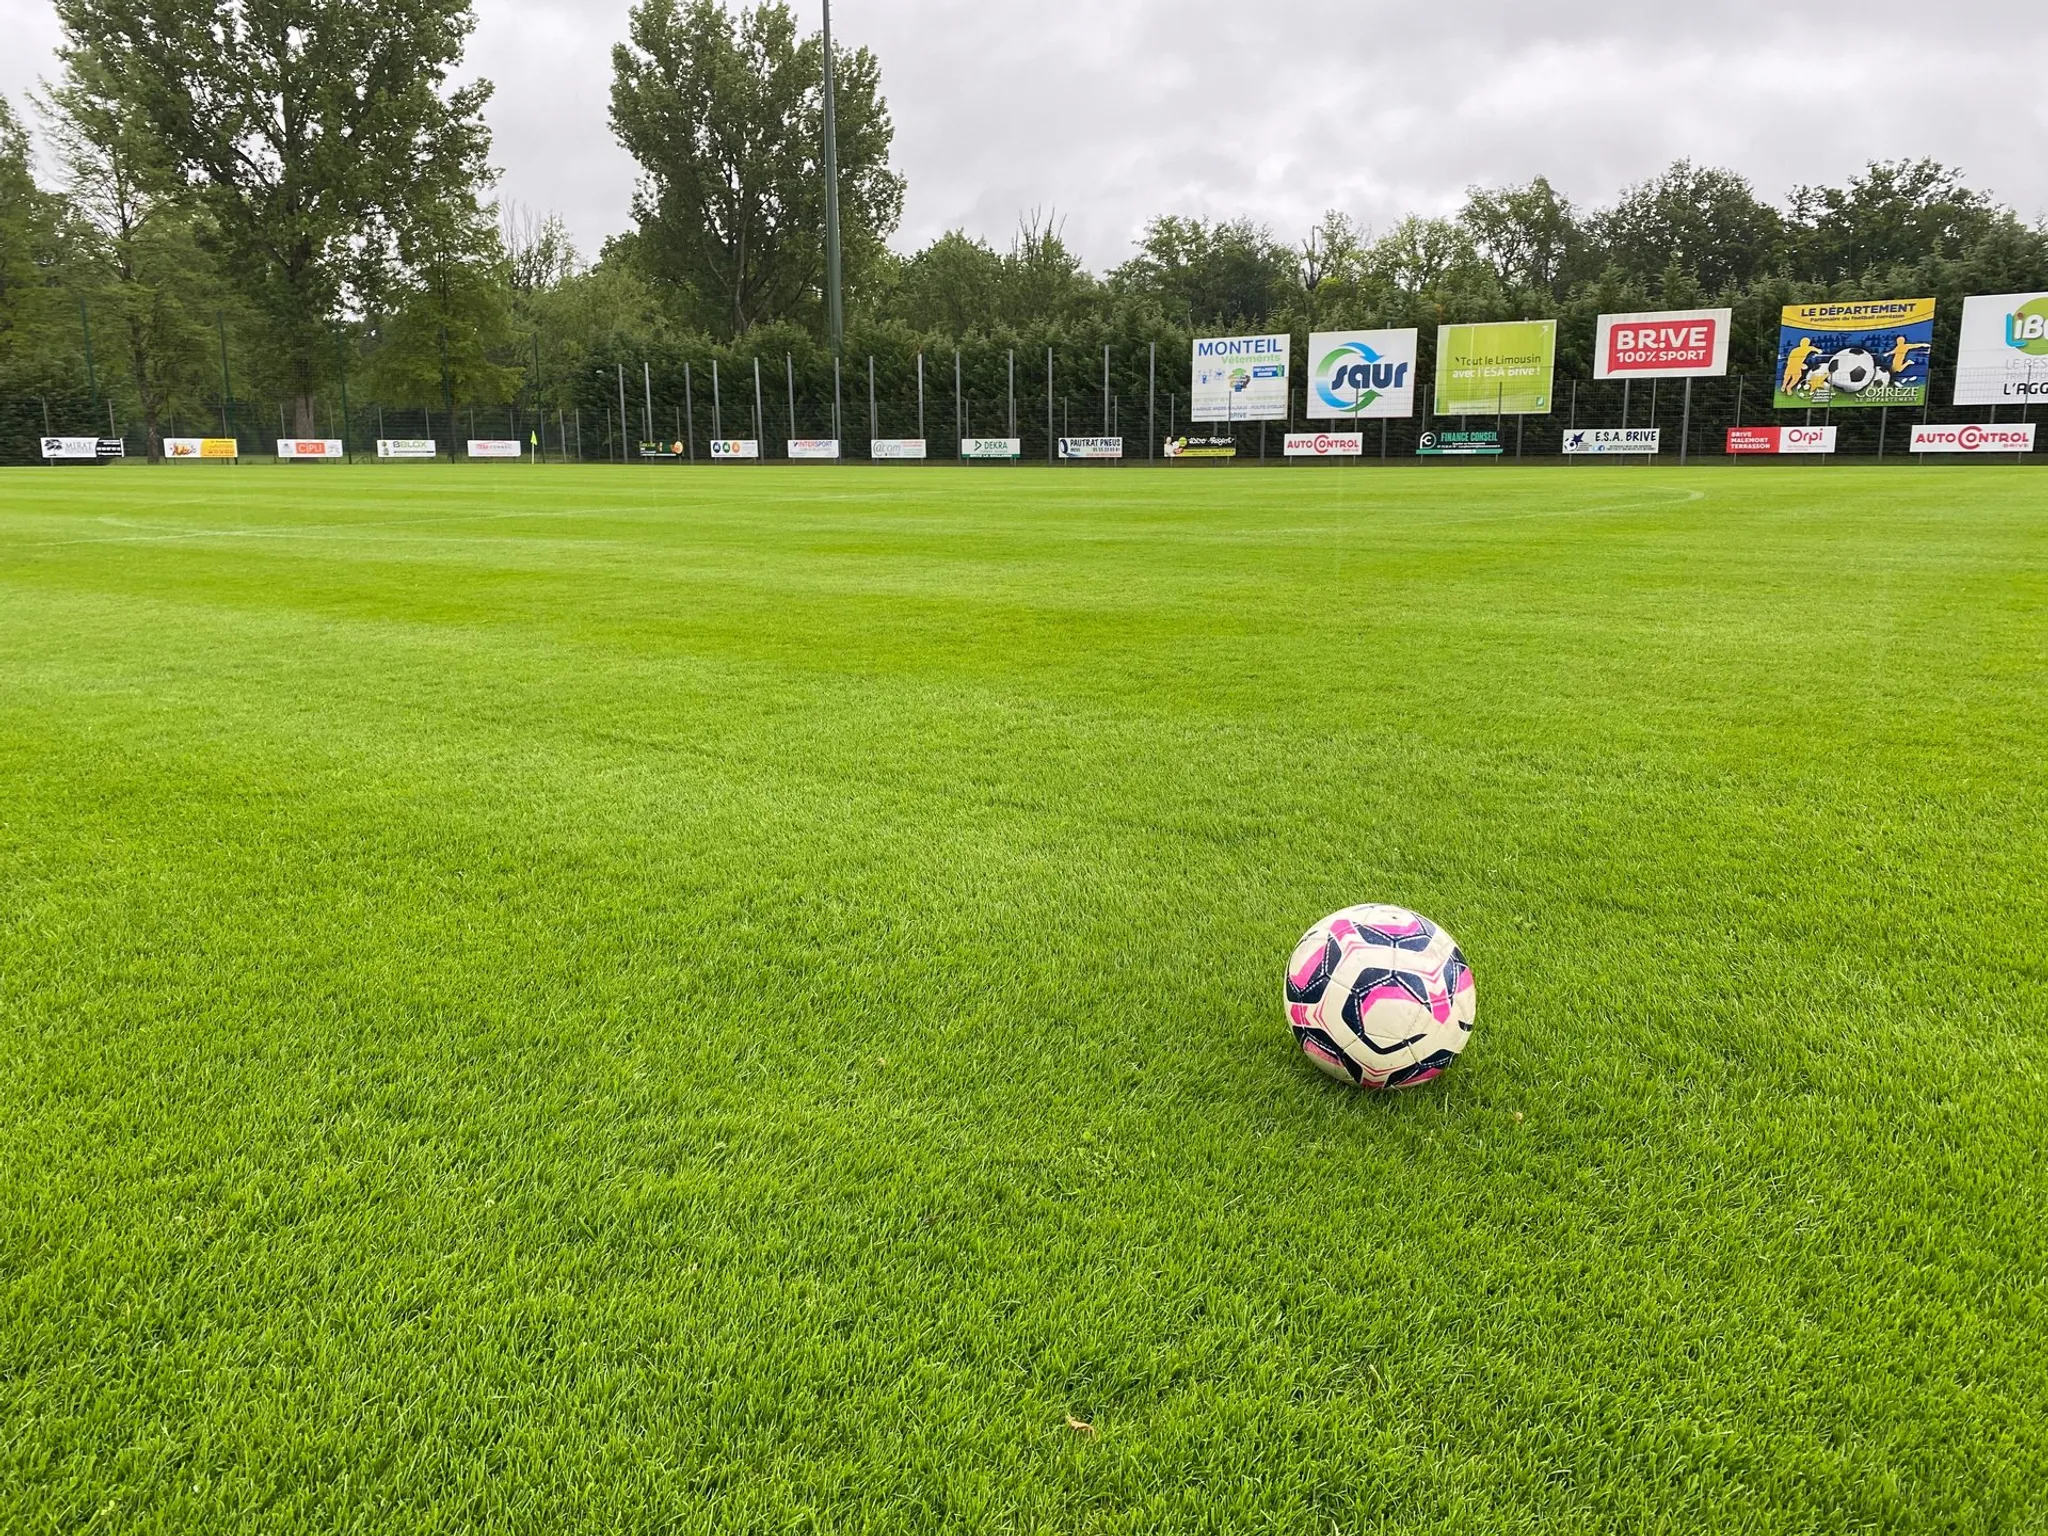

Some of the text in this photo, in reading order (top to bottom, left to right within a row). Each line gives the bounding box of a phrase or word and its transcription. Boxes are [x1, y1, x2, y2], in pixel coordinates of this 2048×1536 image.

[1801, 303, 1916, 316] LE DÉPARTEMENT
[1198, 338, 1283, 356] MONTEIL
[1485, 355, 1493, 365] le
[1496, 353, 1541, 365] Limousin
[1616, 350, 1706, 362] 100% SPORT
[1331, 362, 1408, 391] saur
[1452, 369, 1475, 378] avec
[1441, 431, 1498, 442] FINANCE CONSEIL
[1626, 430, 1657, 441] BRIVE
[1788, 428, 1823, 444] Orpi
[798, 440, 833, 448] INTERSPORT
[984, 441, 1008, 449] DEKRA
[1070, 438, 1121, 447] PAUTRAT PNEUS
